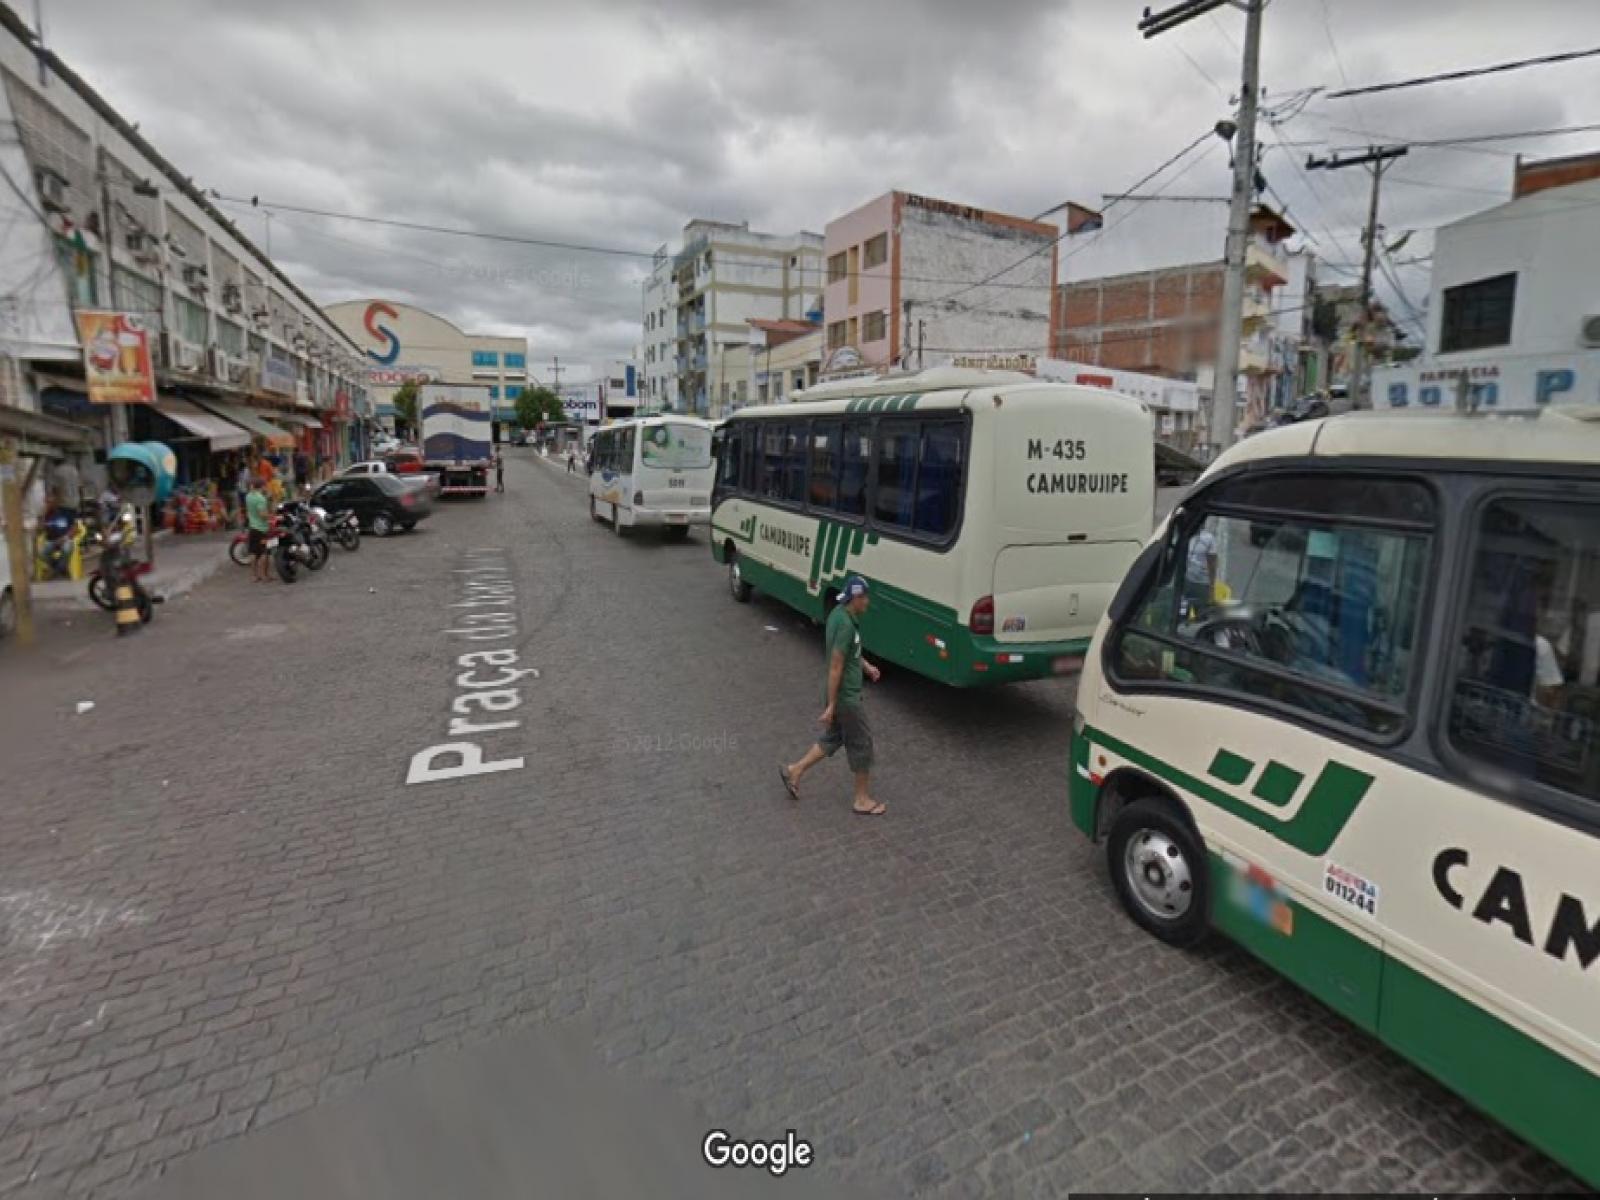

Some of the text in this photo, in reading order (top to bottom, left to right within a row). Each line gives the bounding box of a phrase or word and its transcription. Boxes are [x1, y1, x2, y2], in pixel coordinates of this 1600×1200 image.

[1027, 438, 1086, 460] M-435
[1026, 472, 1128, 494] CAMURUJIPE
[760, 523, 809, 558] CAMURUJIPE
[1325, 876, 1375, 915] 011244
